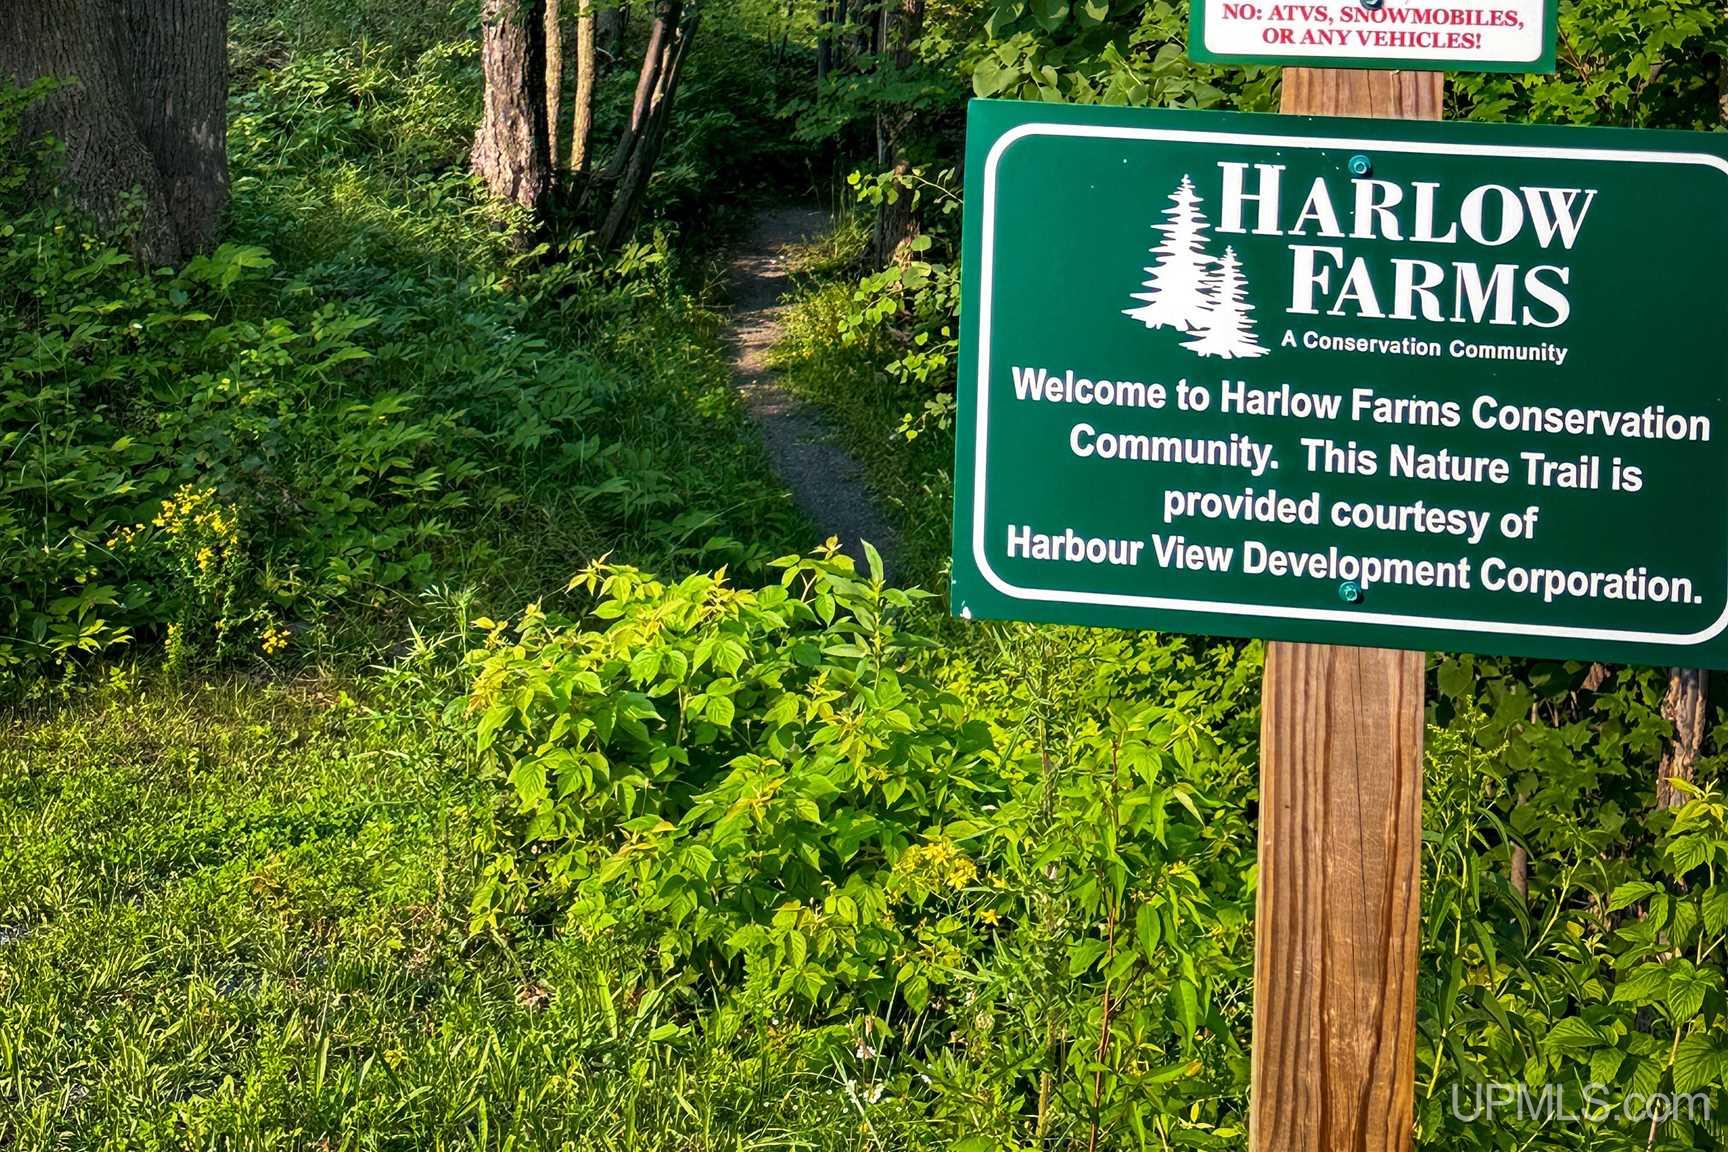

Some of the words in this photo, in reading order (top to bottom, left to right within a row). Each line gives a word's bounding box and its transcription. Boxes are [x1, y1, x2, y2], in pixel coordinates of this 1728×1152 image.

[1222, 3, 1262, 21] NO:
[1269, 5, 1334, 26] ATVS,
[1340, 6, 1524, 29] SNOWMOBILES,
[1262, 27, 1295, 45] OR
[1300, 29, 1353, 47] ANY
[1357, 30, 1482, 49] VEHICLES!
[1214, 161, 1598, 250] HARLOW
[1286, 244, 1572, 328] FARMS
[1281, 330, 1297, 347] A
[1302, 331, 1442, 357] Conservation
[1449, 340, 1568, 365] Community
[1012, 366, 1167, 409] Welcome
[1176, 379, 1210, 411] to
[1221, 379, 1341, 421] Harlow
[1351, 387, 1461, 428] Farms
[1471, 395, 1711, 442] Conservation
[1069, 423, 1280, 476] Community.
[1301, 437, 1376, 475] This
[1389, 443, 1510, 484] Nature
[1521, 451, 1600, 491] Trail
[1611, 455, 1644, 492] is
[1163, 488, 1320, 525] provided
[1331, 501, 1489, 543] courtesy
[1500, 506, 1539, 539] of
[1006, 524, 1143, 567] Harbour
[1152, 533, 1233, 572] View
[1243, 540, 1471, 591] Development
[1480, 557, 1704, 604] Corporation.
